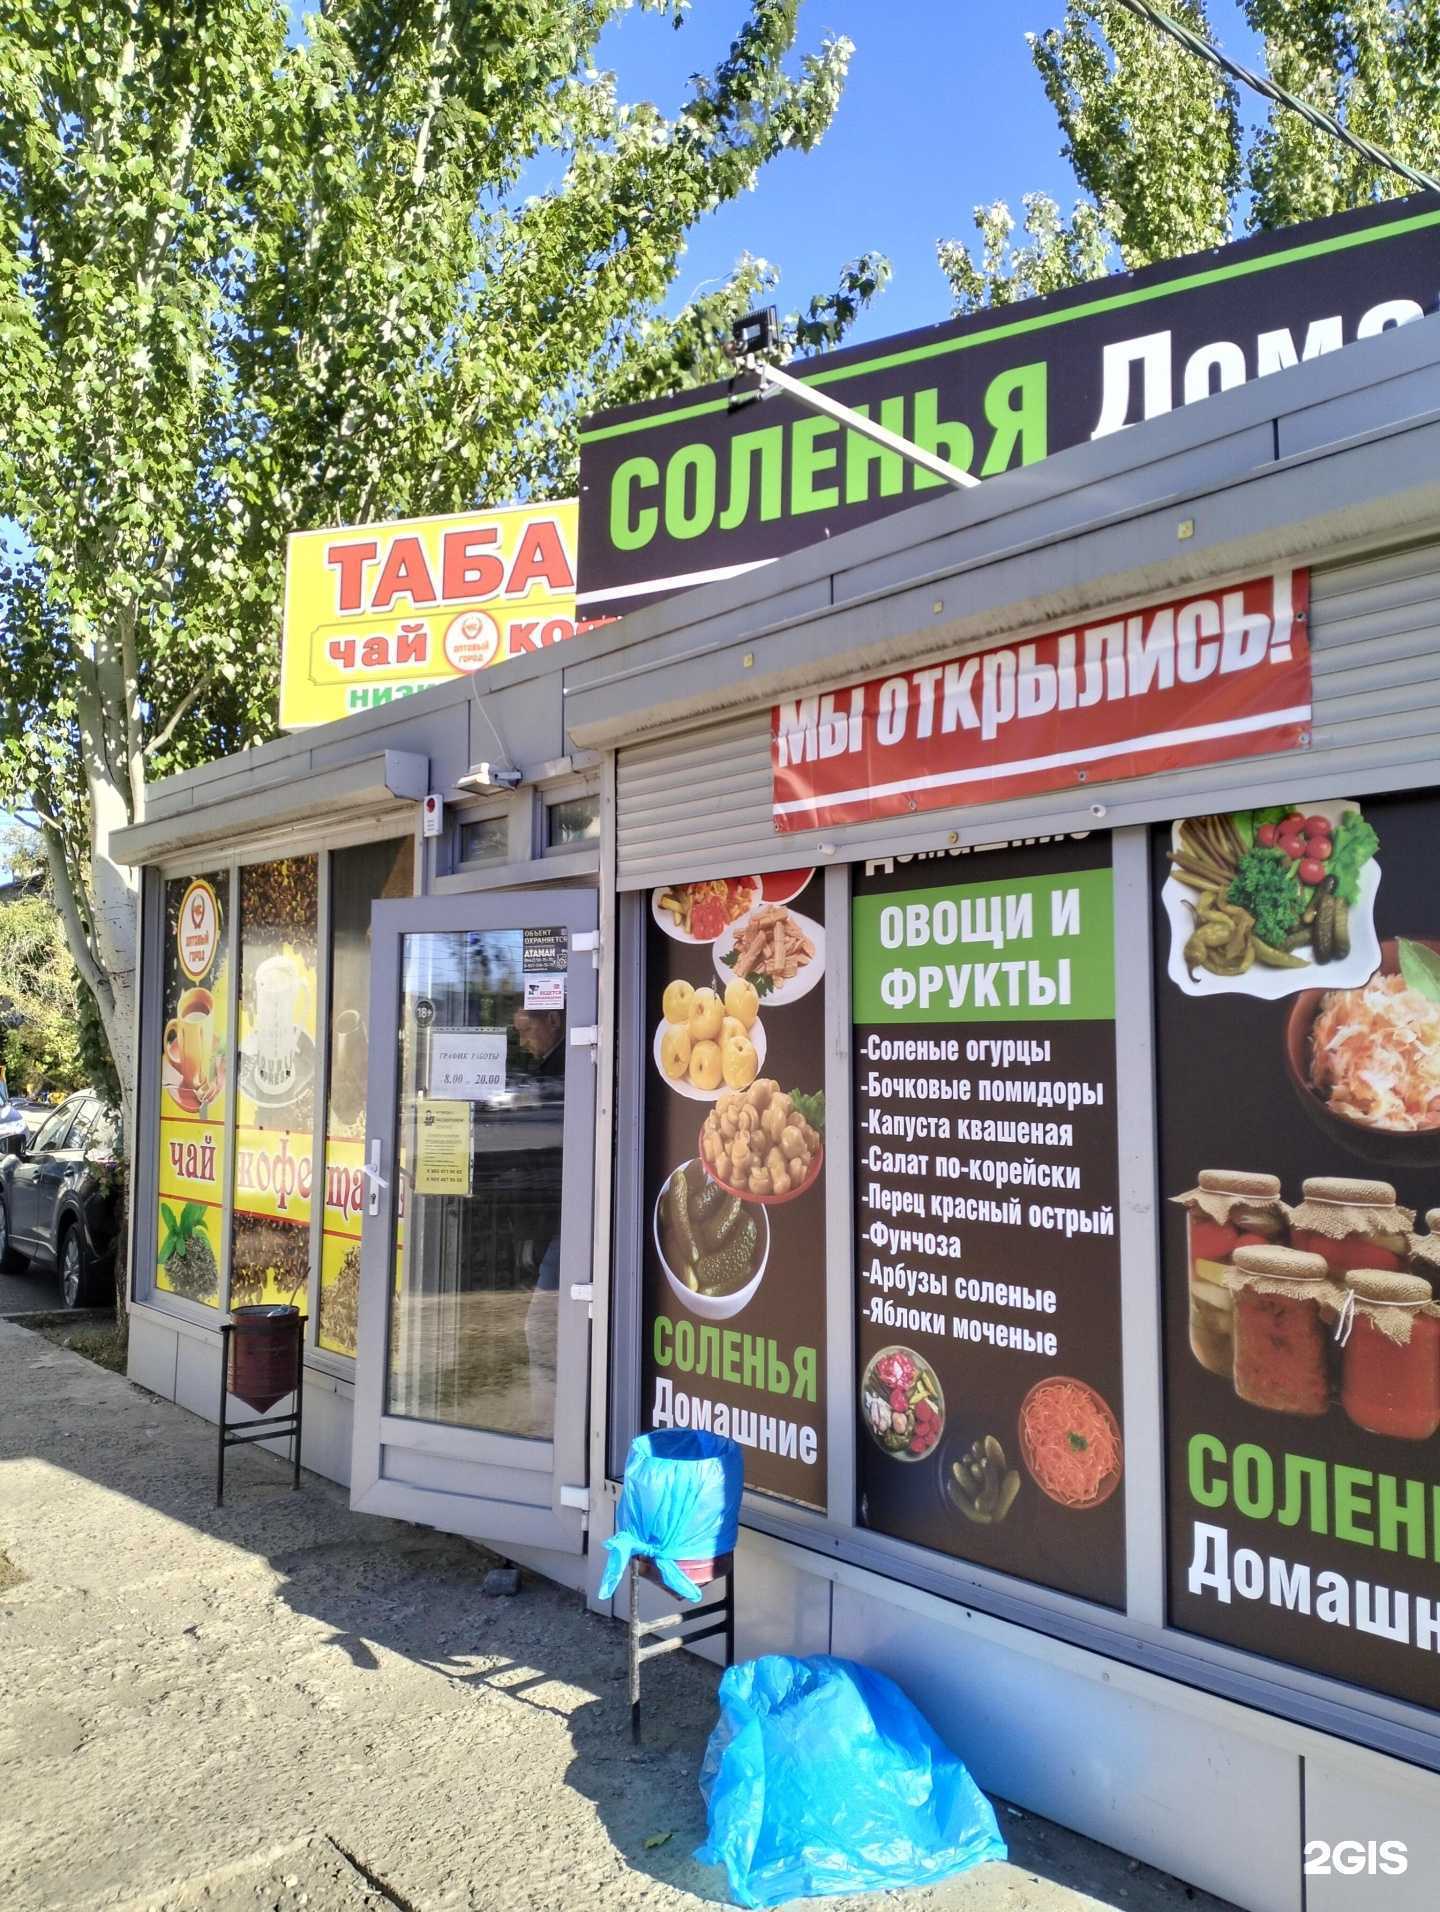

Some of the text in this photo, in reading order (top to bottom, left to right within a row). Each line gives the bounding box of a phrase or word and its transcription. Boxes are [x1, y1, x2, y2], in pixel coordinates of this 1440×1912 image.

[610, 361, 1047, 551] СОЛЕНЬЯ
[328, 623, 428, 669] чай
[879, 887, 1081, 950] ОВОЩИ И
[880, 958, 1072, 1010] ФРУКТЫ
[966, 1039, 1051, 1068] огурцы
[978, 1079, 1104, 1111] помидоры
[957, 1118, 1073, 1147] квашеная
[169, 1135, 216, 1181] чай
[935, 1156, 1081, 1190] по-корейски
[930, 1193, 1022, 1225] красный
[1028, 1203, 1115, 1238] острый
[954, 1276, 1057, 1314] соленые
[653, 1315, 817, 1404] СОЛЕНЬЯ
[952, 1317, 1058, 1357] моченые
[652, 1376, 818, 1466] Домашние
[1187, 1432, 1440, 1565] СОЛЕН
